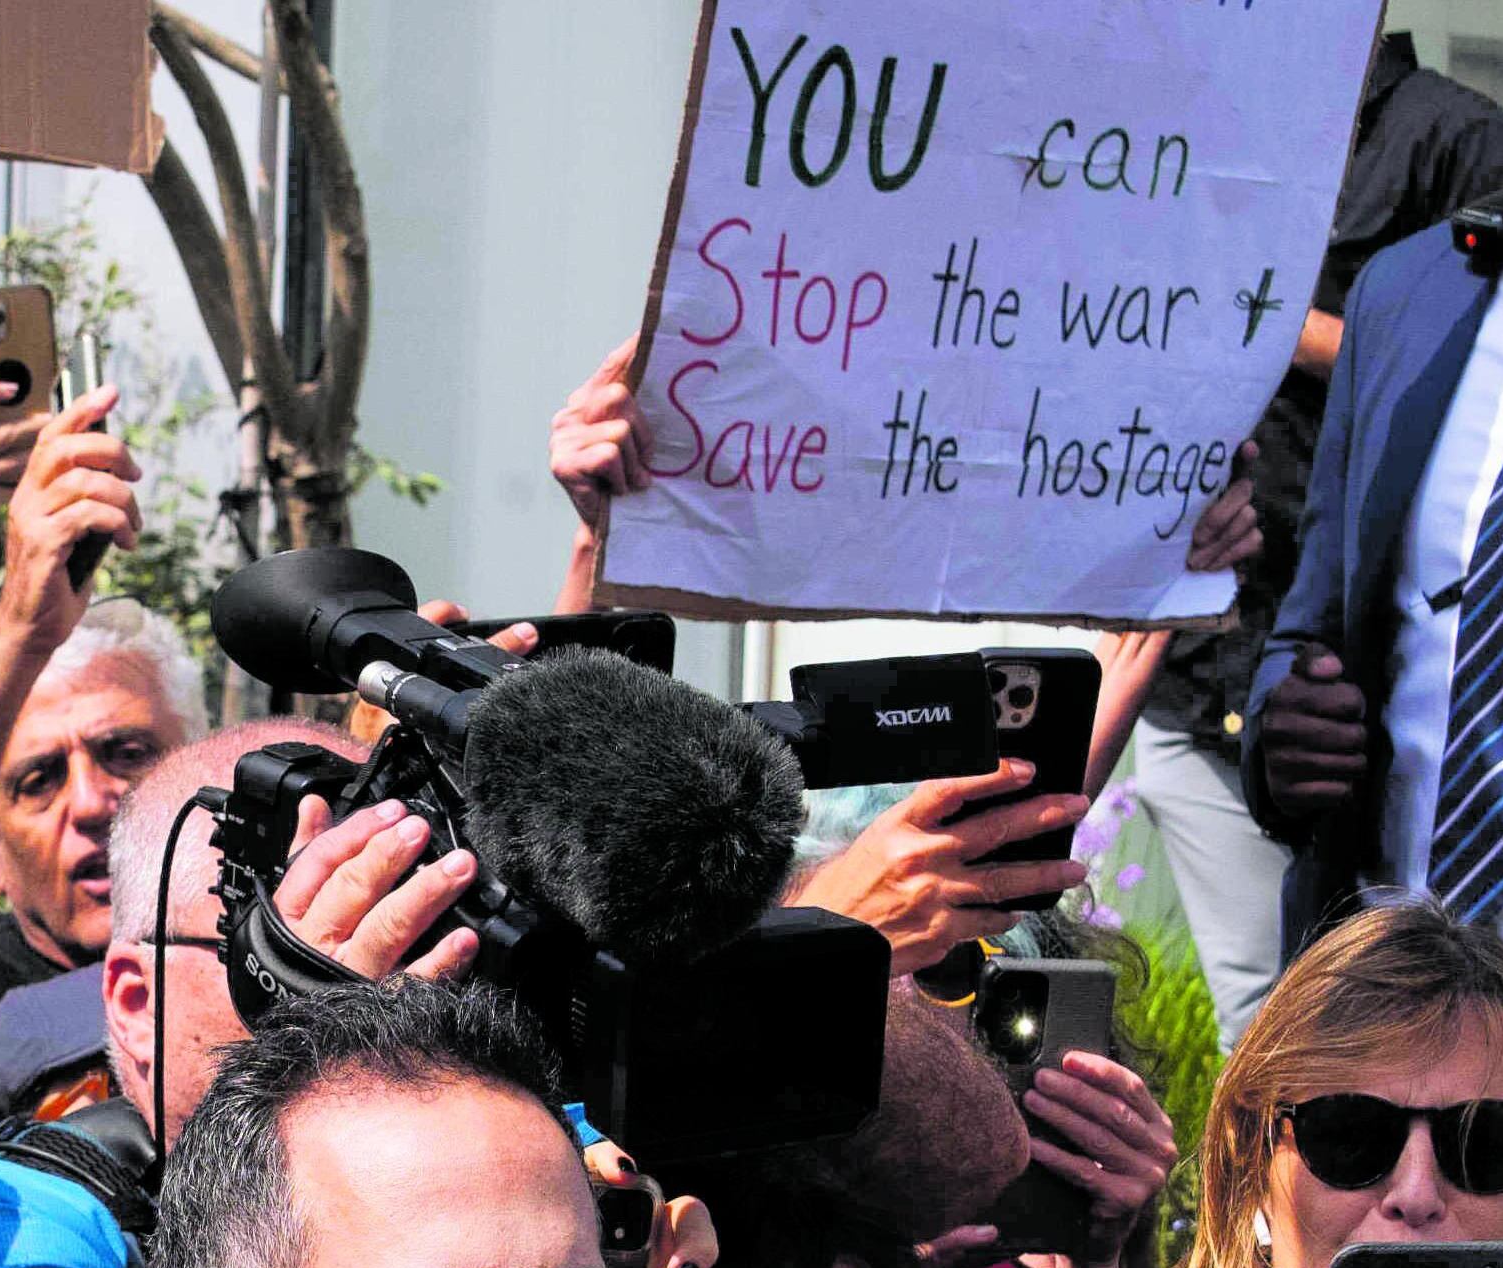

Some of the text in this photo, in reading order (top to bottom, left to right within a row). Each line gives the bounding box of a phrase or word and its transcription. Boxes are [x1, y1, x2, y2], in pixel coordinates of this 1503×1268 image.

[730, 27, 1190, 200] YOU can
[680, 217, 888, 371] Stop
[931, 237, 1021, 350] the
[1060, 278, 1201, 352] war
[641, 359, 1229, 540] Save the hostage
[875, 706, 951, 727] XDCAM
